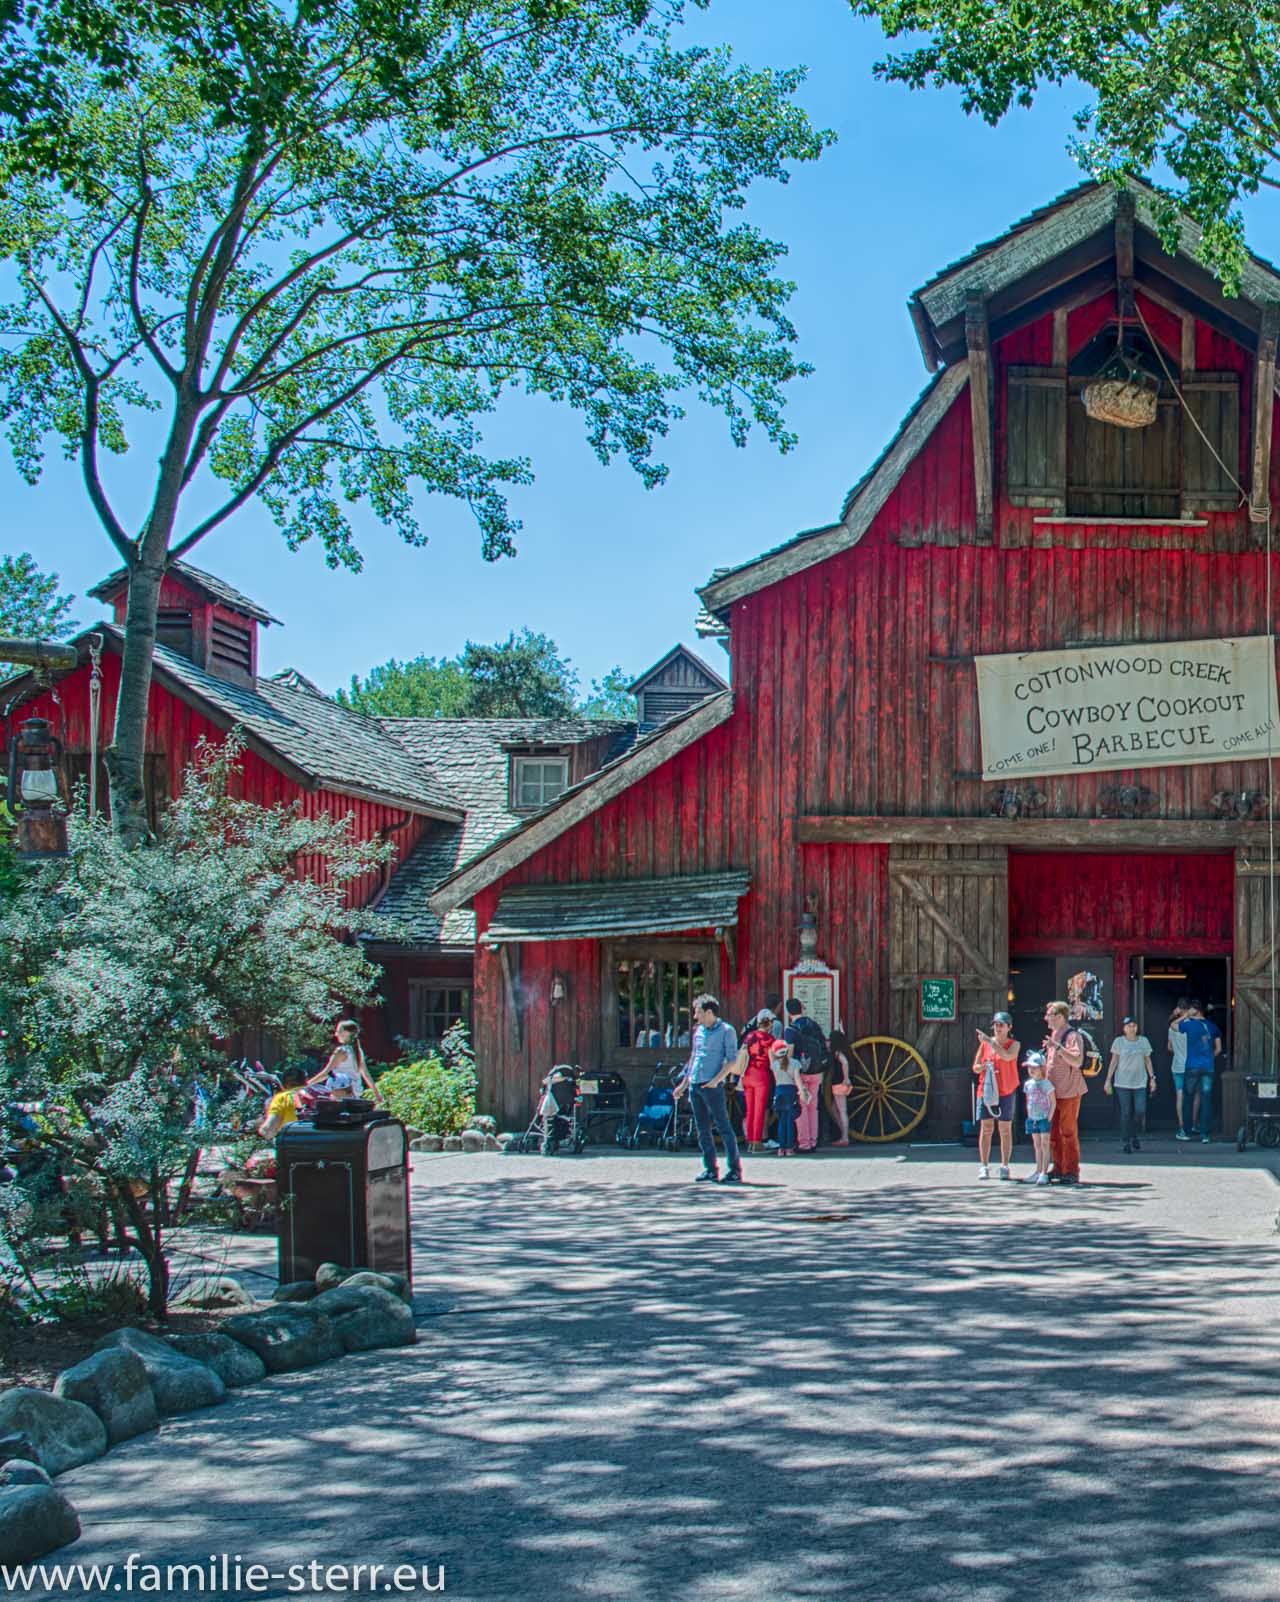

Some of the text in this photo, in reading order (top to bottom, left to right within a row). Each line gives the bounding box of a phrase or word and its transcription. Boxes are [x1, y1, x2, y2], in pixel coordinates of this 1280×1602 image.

[1014, 658, 1232, 701] COTTONWOOD CREEK
[1026, 695, 1245, 734] COWBOY COOKOUT
[987, 737, 1056, 773] COME ONE!
[1073, 725, 1215, 765] BARBECUE
[1223, 730, 1253, 750] COME
